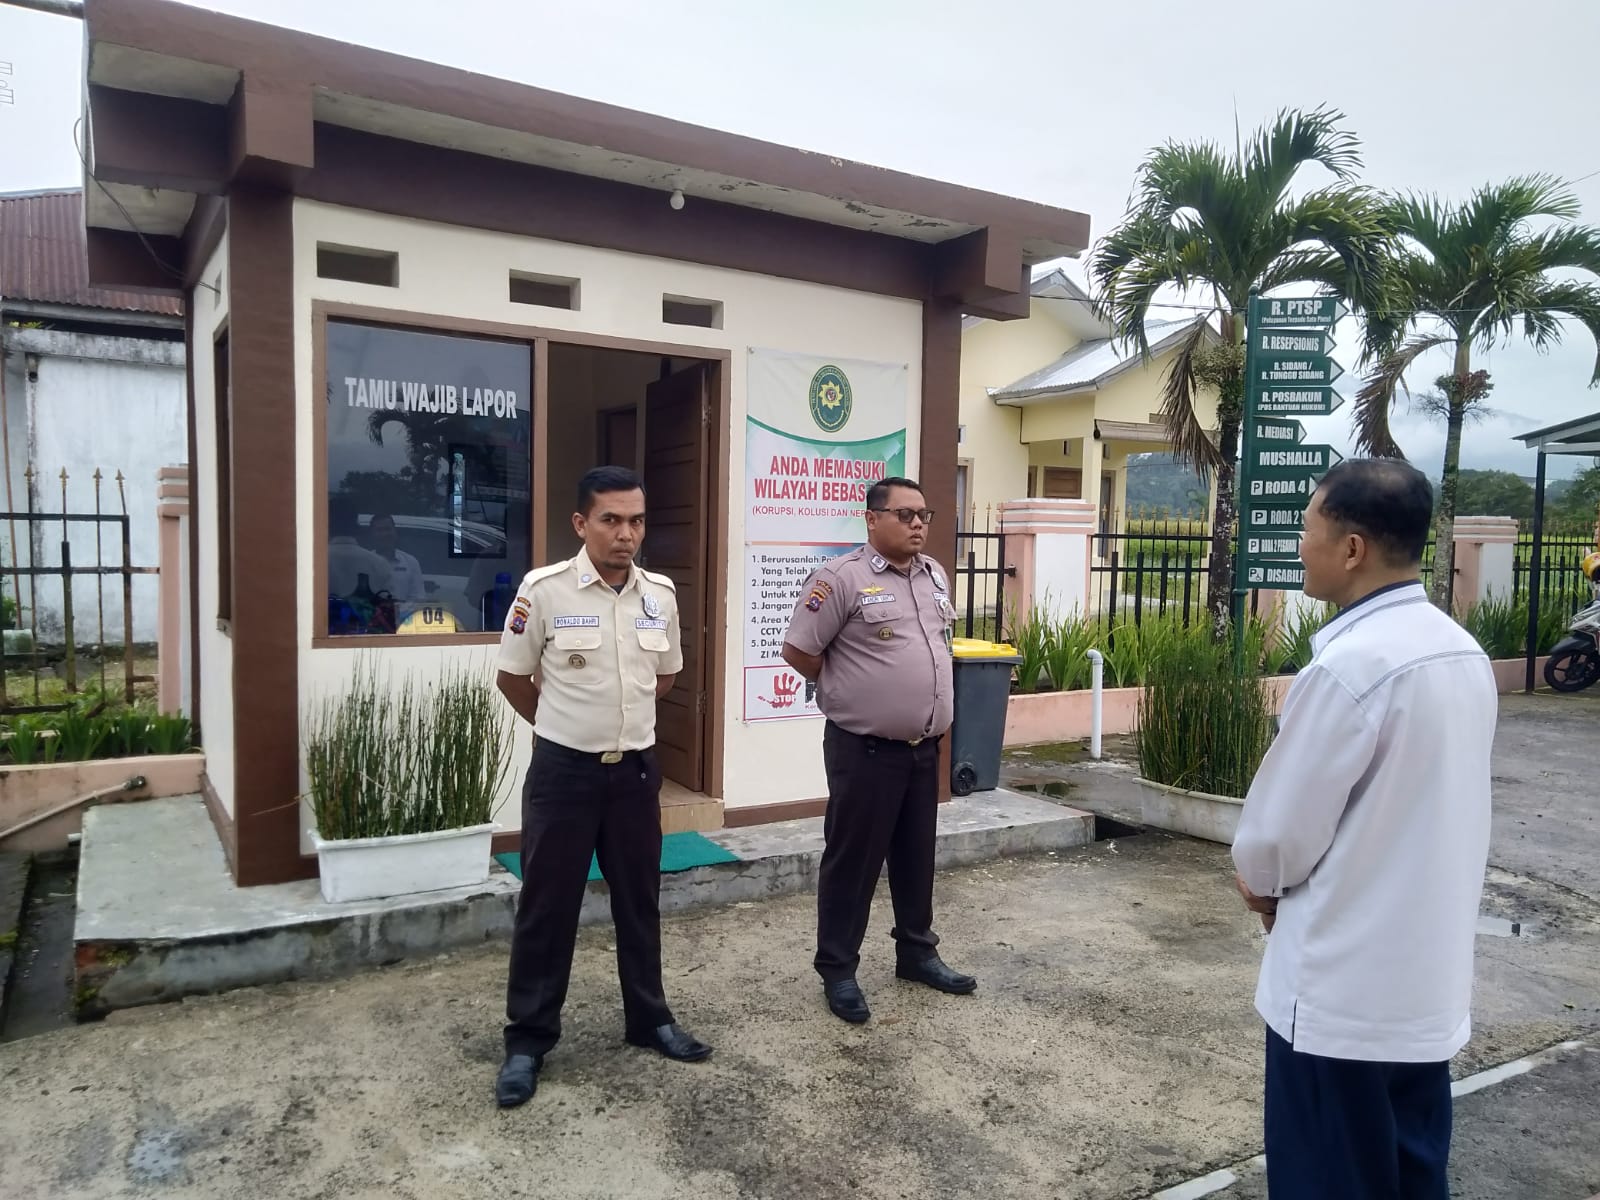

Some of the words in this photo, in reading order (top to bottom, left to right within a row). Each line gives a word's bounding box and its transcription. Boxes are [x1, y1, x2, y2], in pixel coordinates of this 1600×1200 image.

[1272, 301, 1284, 316] R.
[1288, 300, 1323, 315] PTSP
[1262, 336, 1269, 349] R.
[1271, 336, 1320, 351] RESEPSIONIS
[1282, 362, 1307, 370] SIDANG
[1308, 362, 1312, 370] /
[1270, 371, 1297, 380] TUNGGU
[1298, 371, 1324, 379] SIDANG
[344, 376, 397, 410] TAMU
[402, 382, 457, 414] WAJIB
[463, 387, 517, 419] LAPOR
[1262, 392, 1270, 402] R.
[1272, 392, 1322, 402] POSBAKUM
[1265, 426, 1293, 440] MEDIASI
[1260, 452, 1322, 466] MUSHALLA
[770, 455, 809, 476] ANDA
[813, 458, 885, 481] MEMASUKI
[754, 478, 817, 500] WILAYAH
[822, 481, 866, 502] BEBAS
[1265, 481, 1295, 494] RODA
[1298, 480, 1306, 493] 4
[752, 505, 795, 517] (KORUPSI,
[798, 507, 829, 516] KOLUSI
[831, 508, 848, 517] DAN
[851, 509, 866, 518] NEP
[1271, 510, 1292, 525] RODA
[1294, 510, 1301, 525] 2
[761, 567, 782, 576] Yang
[761, 579, 792, 588] Jangan
[761, 602, 793, 611] Jangan
[423, 607, 444, 625] 04
